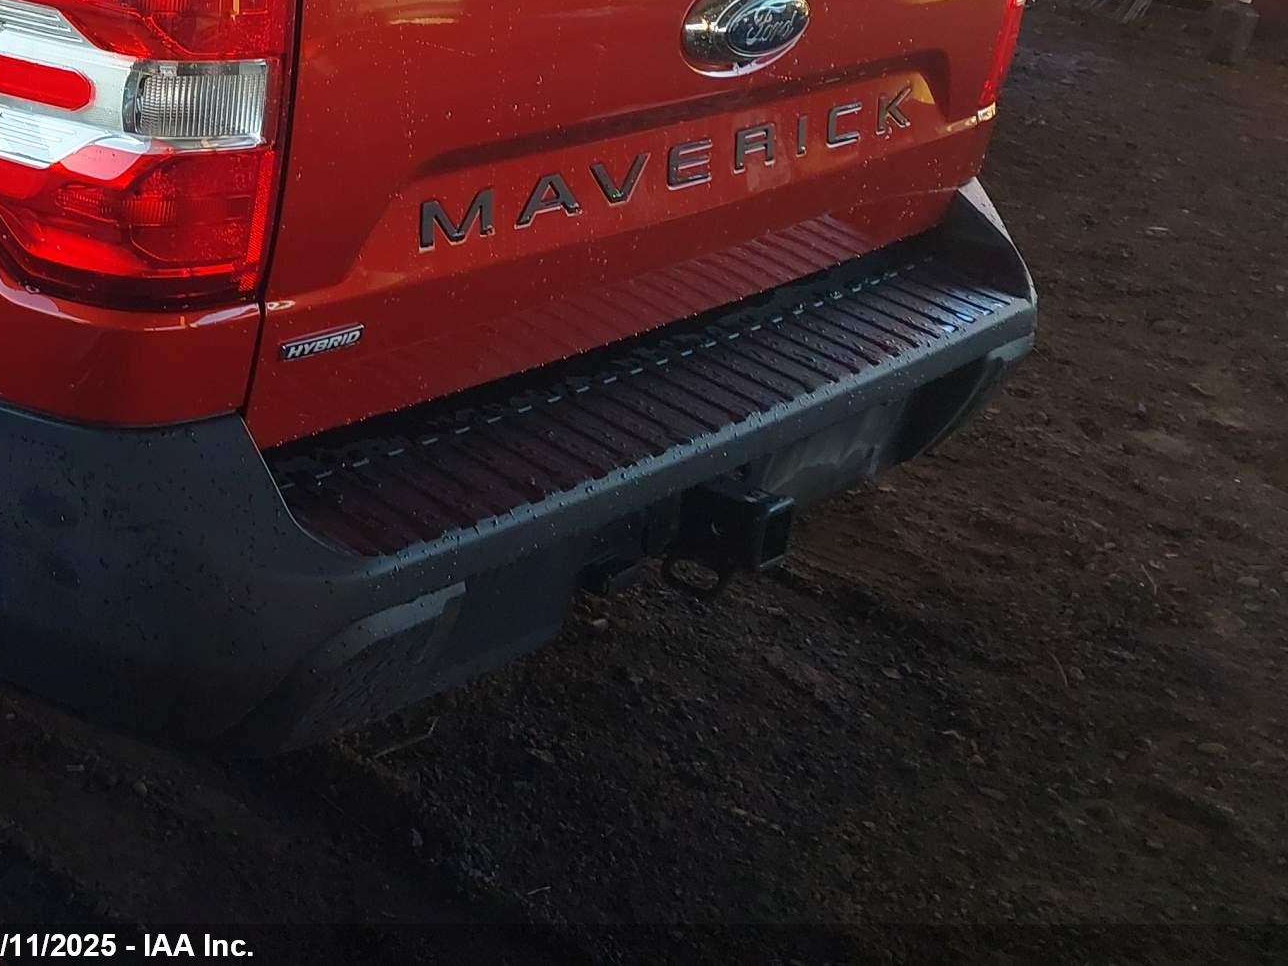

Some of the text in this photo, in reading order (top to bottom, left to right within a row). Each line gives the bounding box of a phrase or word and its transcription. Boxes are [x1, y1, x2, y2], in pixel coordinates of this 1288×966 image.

[746, 3, 798, 46] Ford
[418, 87, 913, 253] MAVERICK
[287, 330, 361, 358] HYBRID
